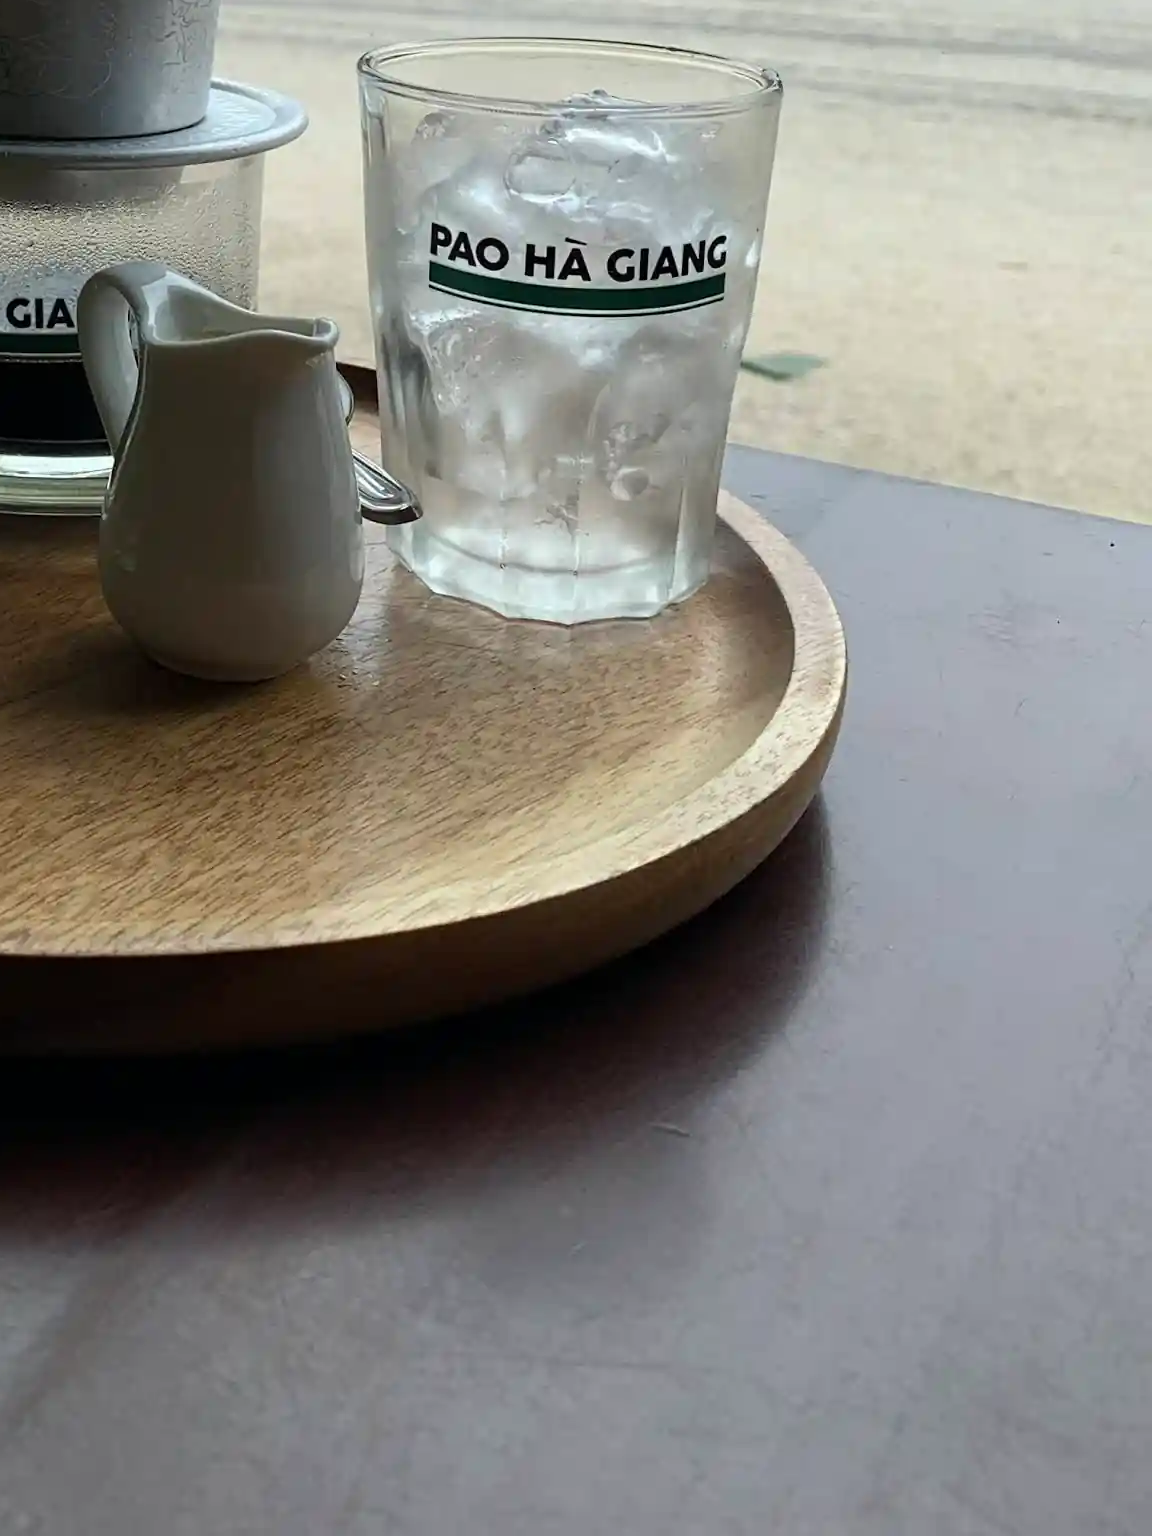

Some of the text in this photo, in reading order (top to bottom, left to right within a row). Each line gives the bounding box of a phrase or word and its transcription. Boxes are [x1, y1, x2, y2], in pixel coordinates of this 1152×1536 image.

[430, 222, 727, 282] PAO HÀ GIANG
[6, 298, 75, 329] GIA
